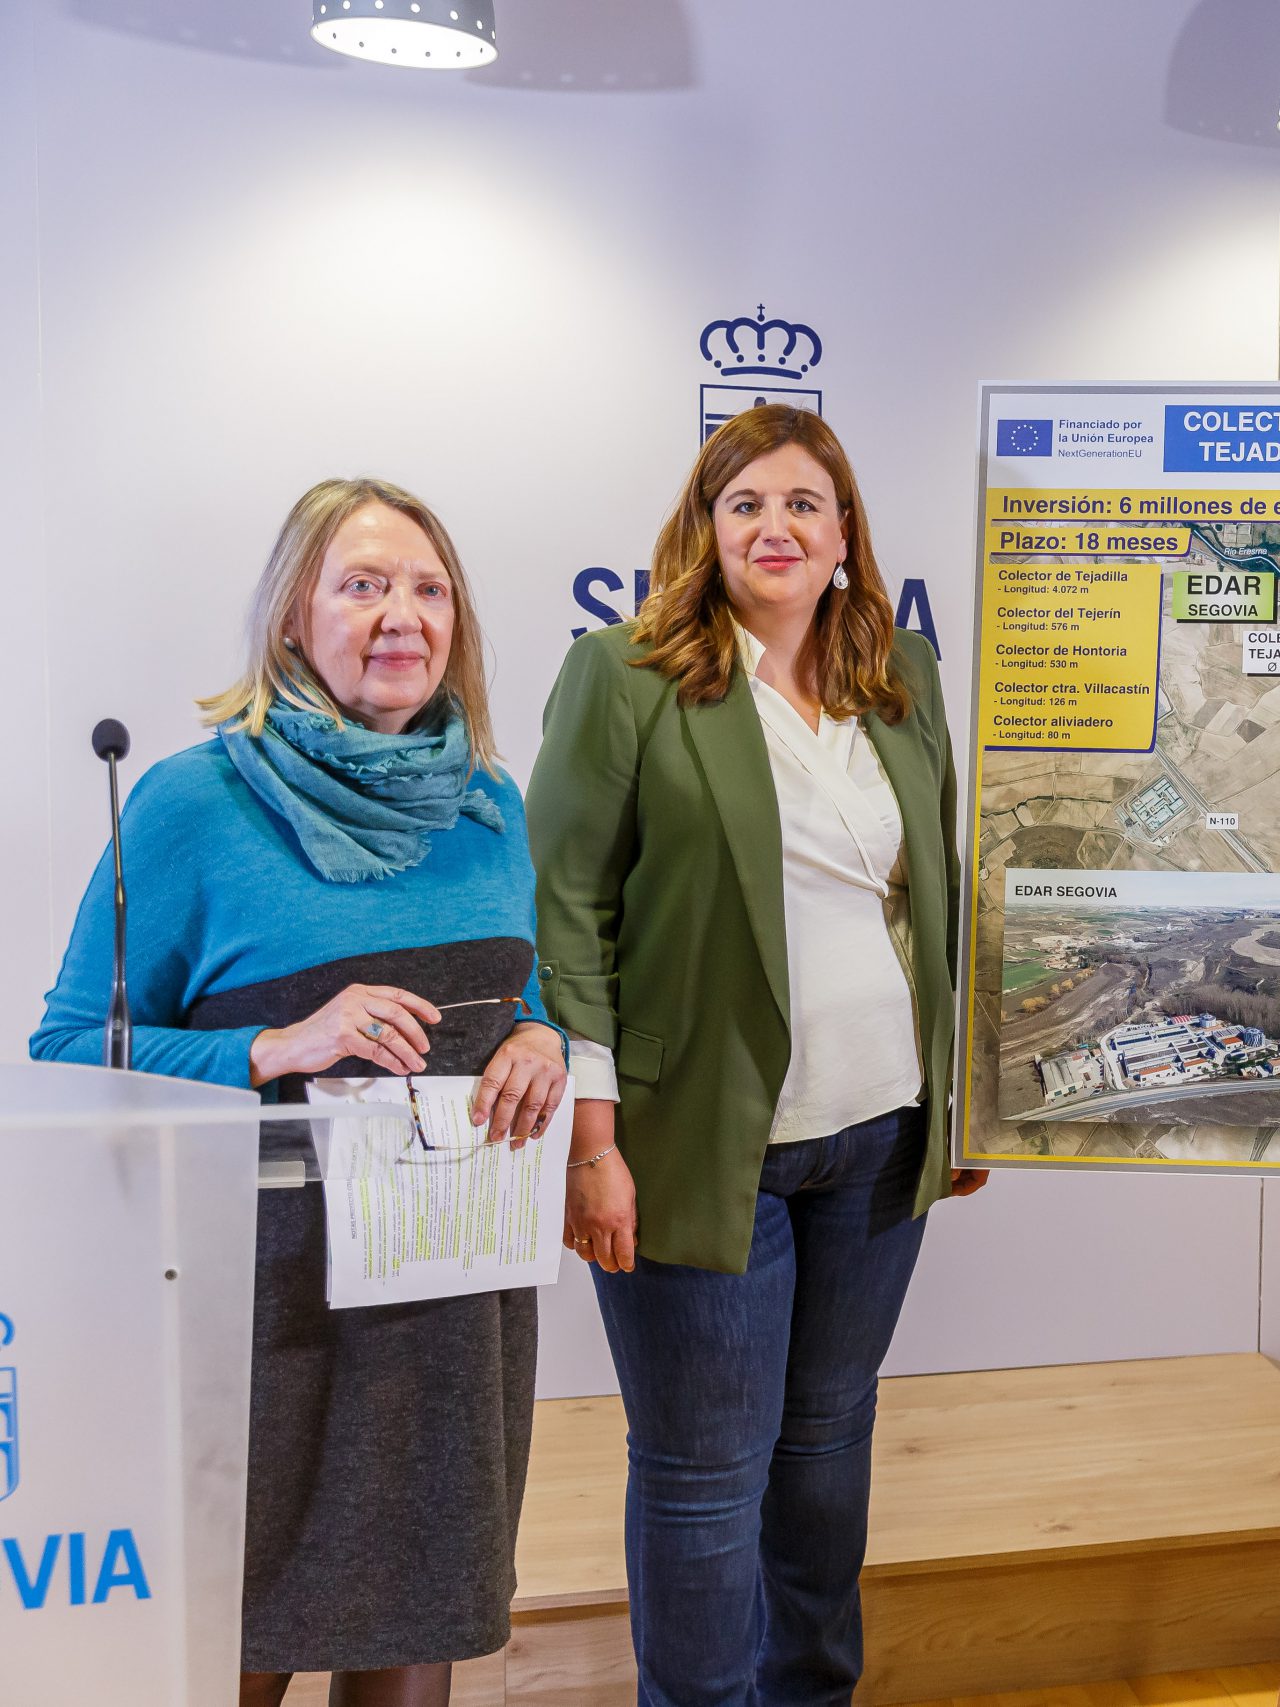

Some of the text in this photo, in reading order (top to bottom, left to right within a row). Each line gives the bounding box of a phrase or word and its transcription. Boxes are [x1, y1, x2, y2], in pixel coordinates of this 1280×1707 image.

[1059, 419, 1142, 431] Financiado por
[1058, 433, 1154, 445] la Unión Europea
[1058, 449, 1142, 458] NextGenerationEU
[1003, 495, 1112, 514] Inversión:
[1119, 497, 1132, 514] 6
[1139, 497, 1232, 515] millones
[1240, 497, 1267, 515] de
[1000, 531, 1178, 551] Plazo: 18 meses
[1238, 547, 1268, 556] Eresma
[998, 570, 1128, 584] Colector de Tejadilla
[1004, 585, 1049, 595] Longitud:
[1052, 586, 1078, 594] 4.072
[1187, 575, 1261, 596] EDAR
[997, 607, 1121, 621] Colector del Tejerín
[1188, 604, 1259, 617] SEGOVIA
[1002, 622, 1048, 633] Longitud:
[1051, 623, 1068, 631] 576
[996, 644, 1127, 657] Colector de Hontoria
[1001, 659, 1047, 670] Longitud:
[1049, 660, 1067, 668] 530
[994, 681, 1150, 695] Colector ctra. Villacastín
[1000, 697, 1046, 707] Longitud:
[1049, 698, 1066, 706] 126
[993, 715, 1113, 728] Colector aliviadero
[999, 730, 1045, 741] Longitud:
[1047, 731, 1059, 739] 80
[1209, 817, 1236, 825] N-110
[1015, 885, 1118, 898] EDAR SEGOVIA
[1, 1528, 152, 1611] VIA
